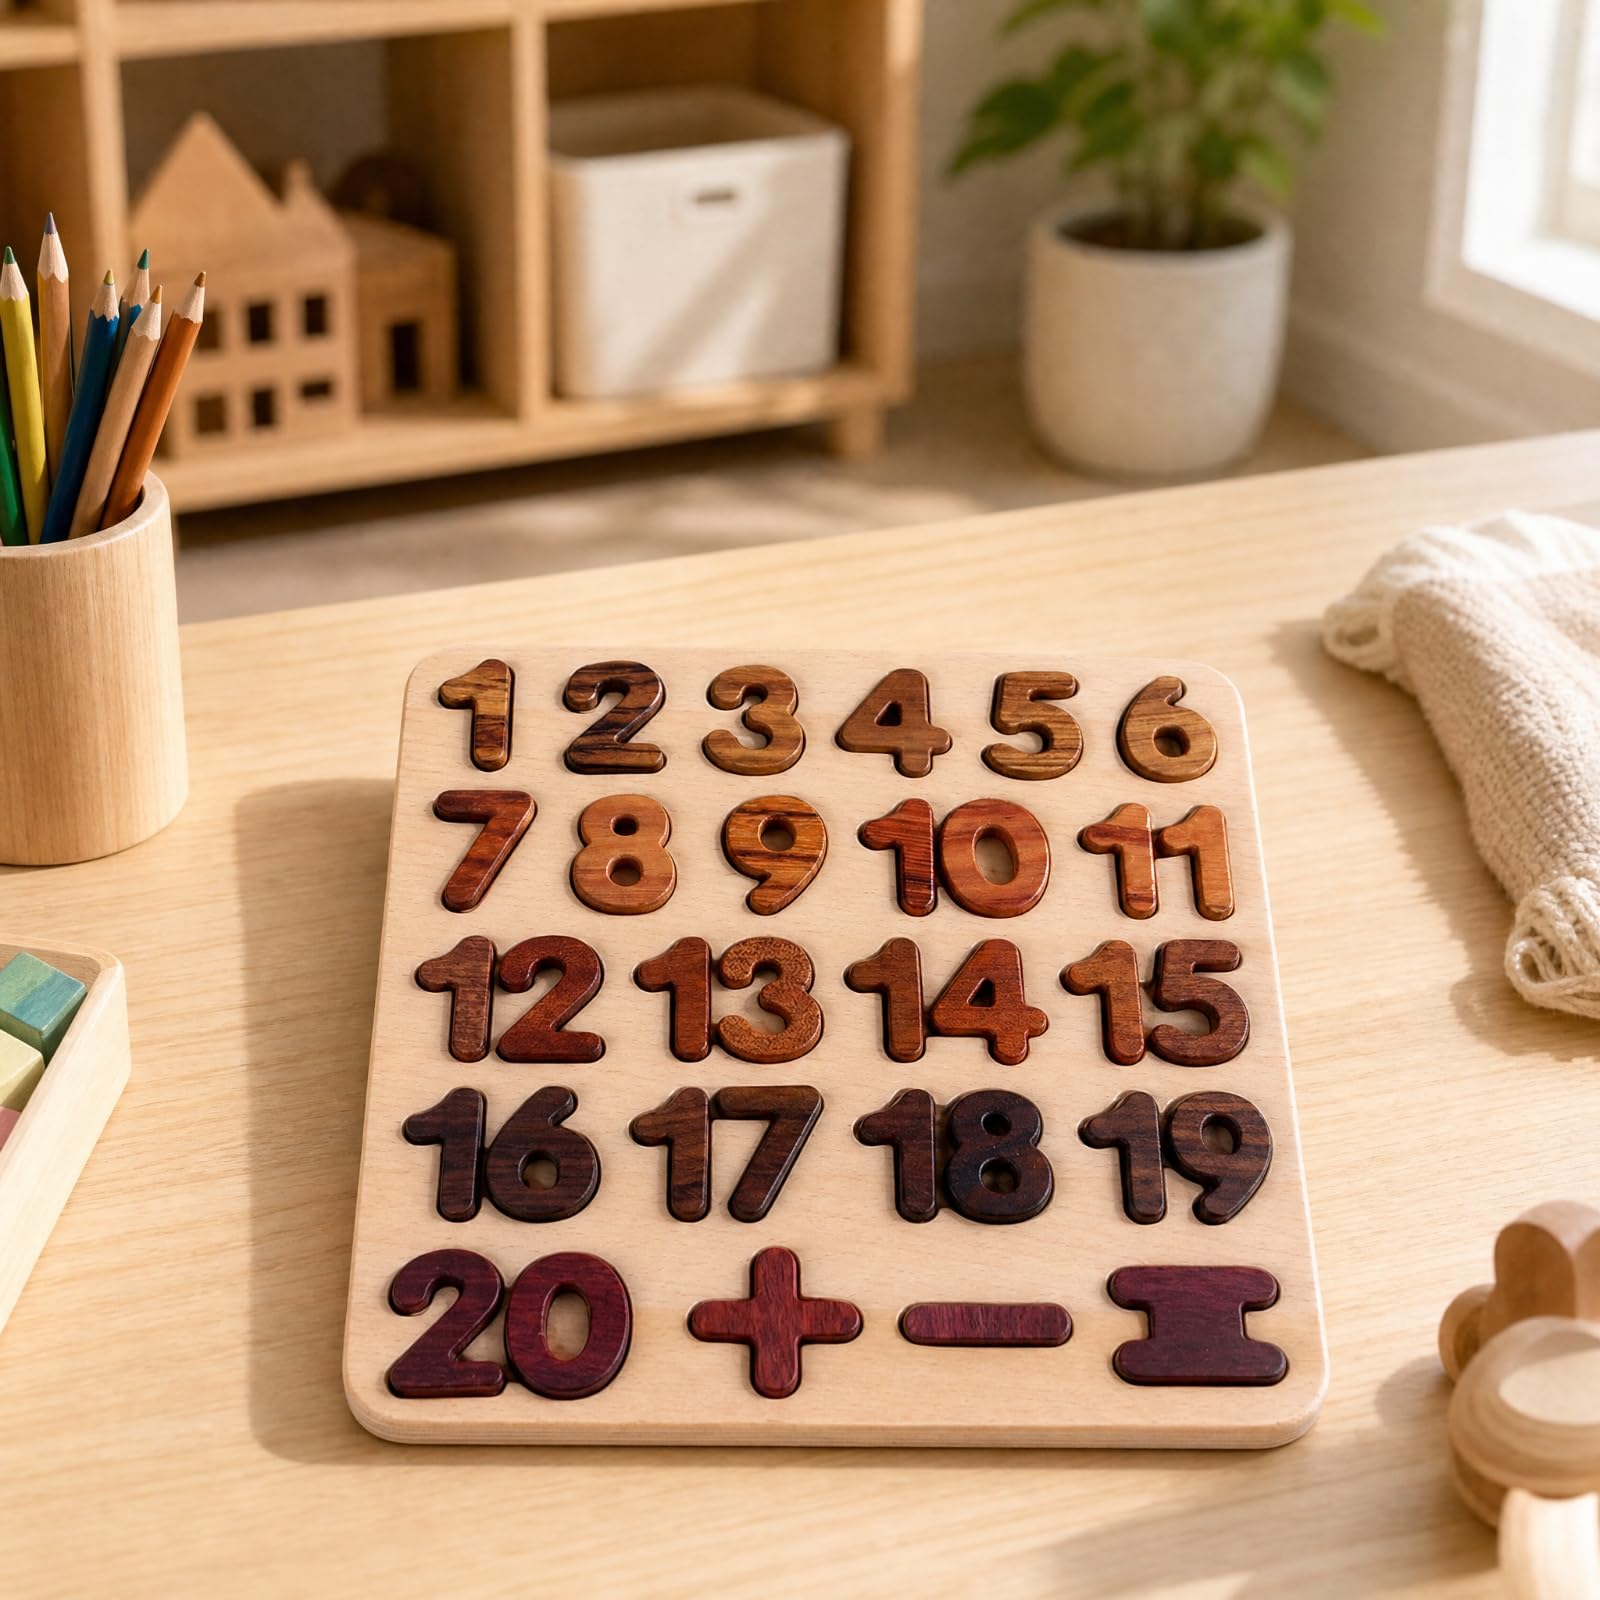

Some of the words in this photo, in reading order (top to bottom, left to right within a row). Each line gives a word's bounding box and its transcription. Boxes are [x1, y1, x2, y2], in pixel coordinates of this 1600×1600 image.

[437, 659, 515, 772] 1
[562, 659, 667, 775] 2
[701, 664, 806, 776] 3
[834, 668, 953, 778] 4
[981, 671, 1084, 781] 5
[1115, 675, 1218, 783] 6
[432, 790, 538, 913] 7
[568, 794, 677, 916] 8
[721, 795, 828, 917] 9
[857, 798, 1051, 919] 10
[1077, 803, 1235, 921] 11
[414, 935, 606, 1064] 12
[633, 936, 825, 1065] 13
[843, 937, 1050, 1066] 14
[1059, 939, 1250, 1067] 15
[401, 1086, 602, 1224] 16
[628, 1085, 825, 1223] 17
[853, 1087, 1056, 1225] 18
[1078, 1090, 1274, 1226] 19
[386, 1249, 634, 1401] 20
